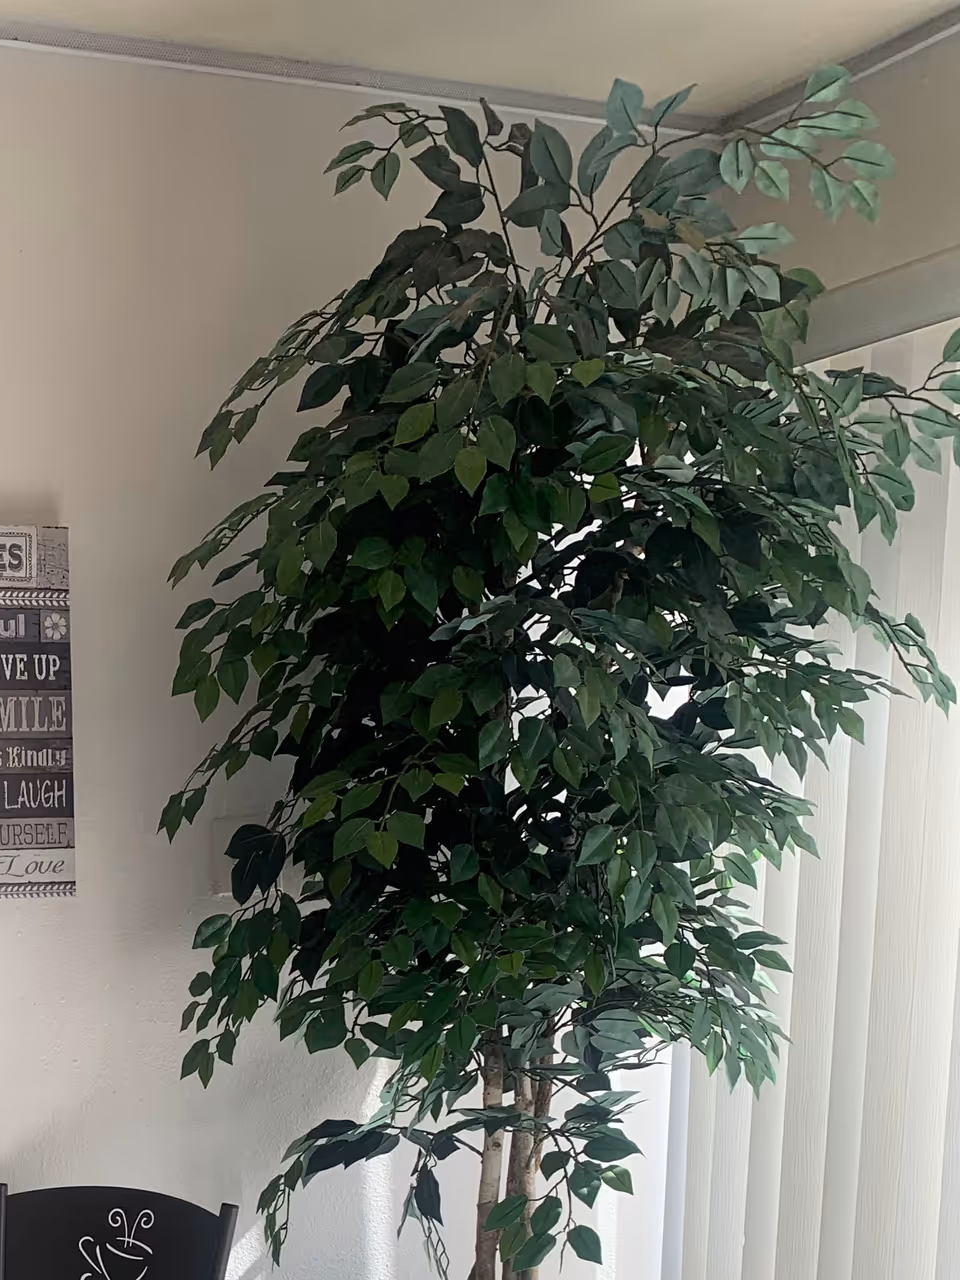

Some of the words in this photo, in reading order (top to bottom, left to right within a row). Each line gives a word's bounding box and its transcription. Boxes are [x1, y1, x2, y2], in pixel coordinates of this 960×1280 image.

[34, 654, 60, 680] UP
[6, 746, 66, 768] Kindly
[4, 780, 66, 809] LAUGH
